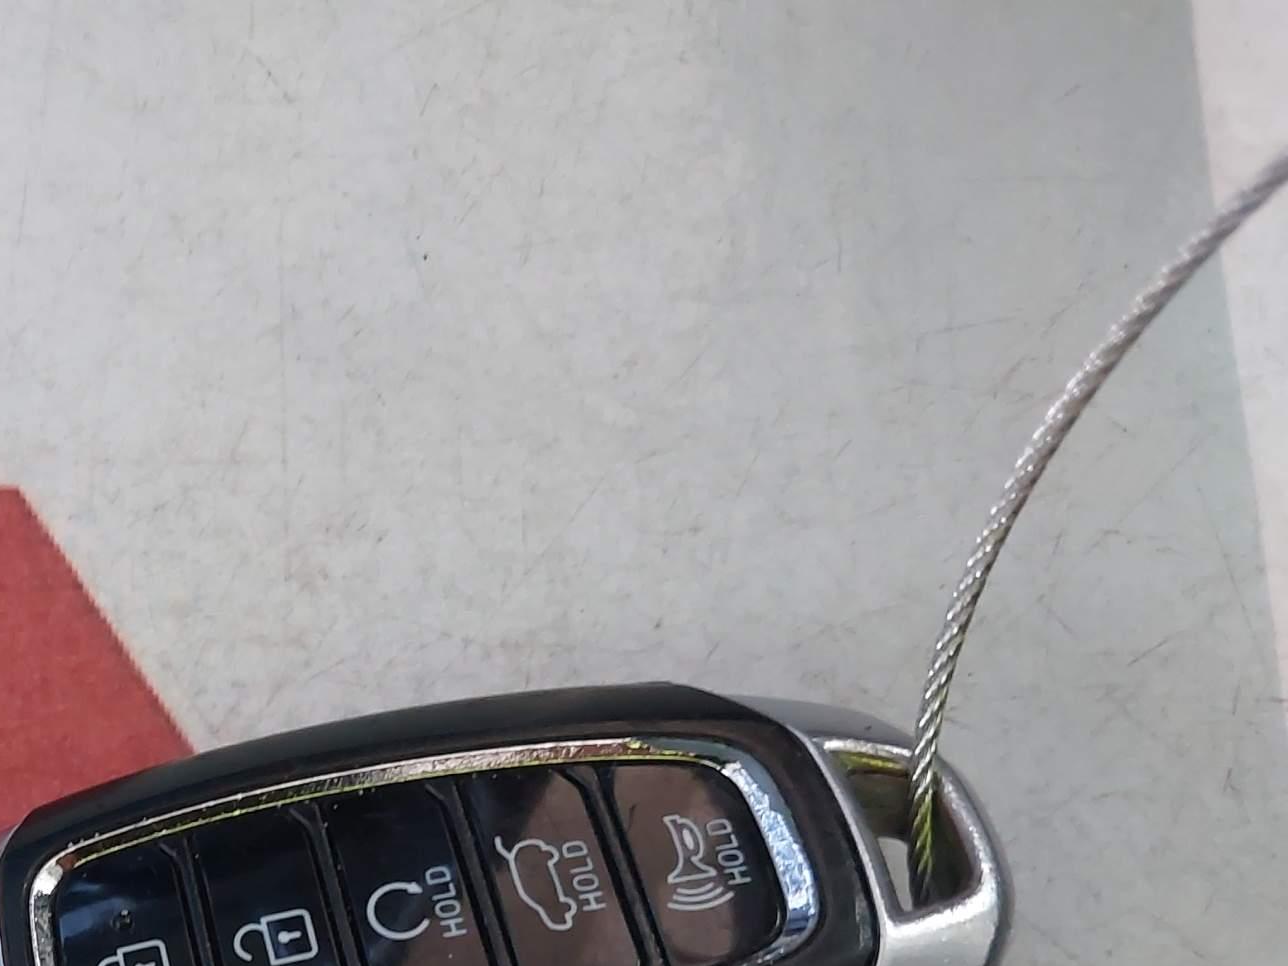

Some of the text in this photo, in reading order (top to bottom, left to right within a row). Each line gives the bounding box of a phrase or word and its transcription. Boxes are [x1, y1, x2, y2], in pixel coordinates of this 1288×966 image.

[561, 839, 606, 912] HOLD
[707, 817, 752, 885] HOLD
[425, 864, 468, 938] HOLD
